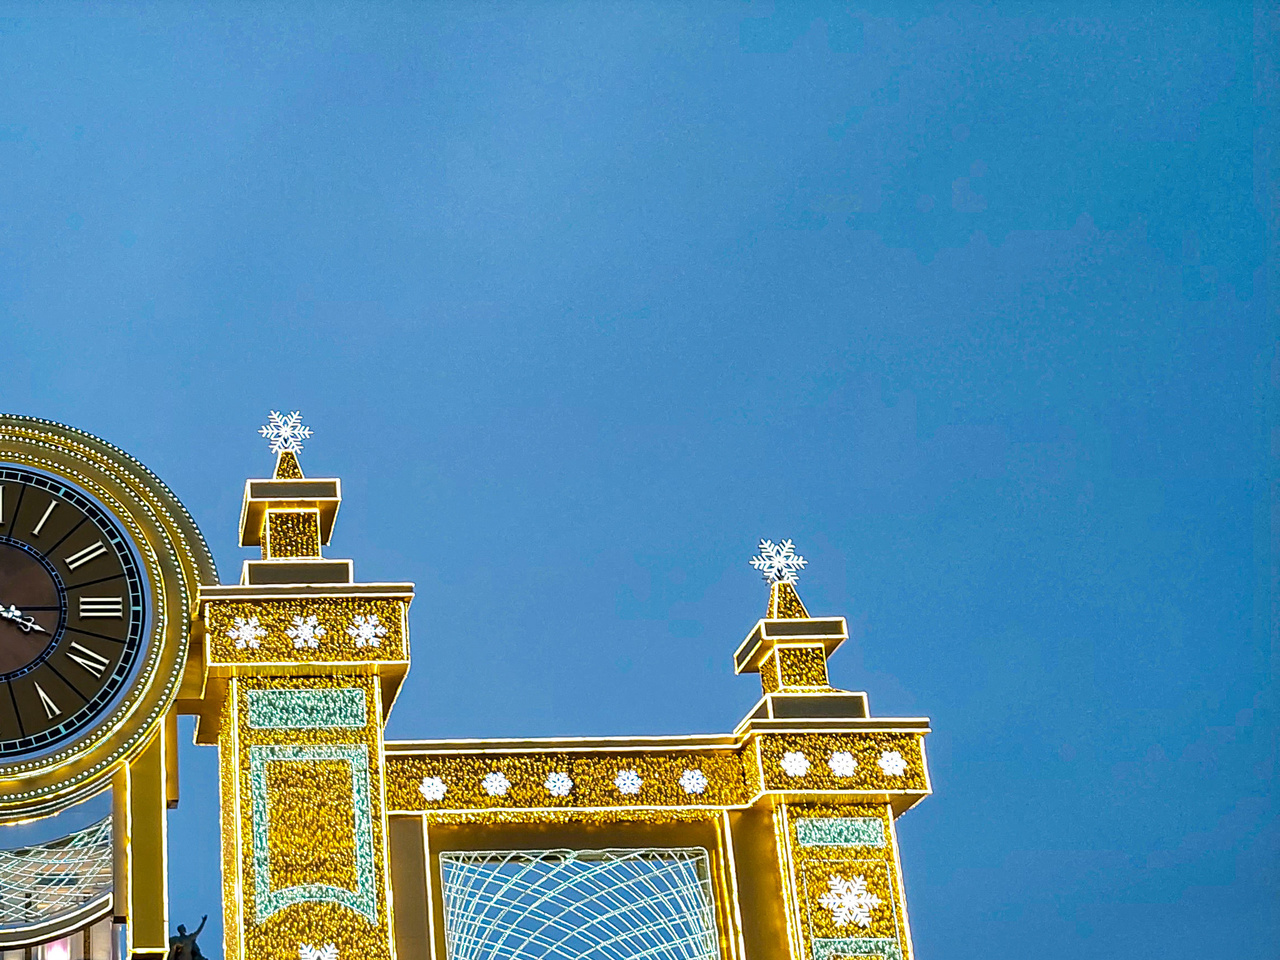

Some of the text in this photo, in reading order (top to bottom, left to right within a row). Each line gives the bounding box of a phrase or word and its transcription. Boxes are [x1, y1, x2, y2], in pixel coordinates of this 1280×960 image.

[30, 499, 59, 536] I
[64, 539, 108, 570] II
[79, 595, 123, 619] III
[65, 640, 110, 679] IV
[34, 680, 62, 720] V
